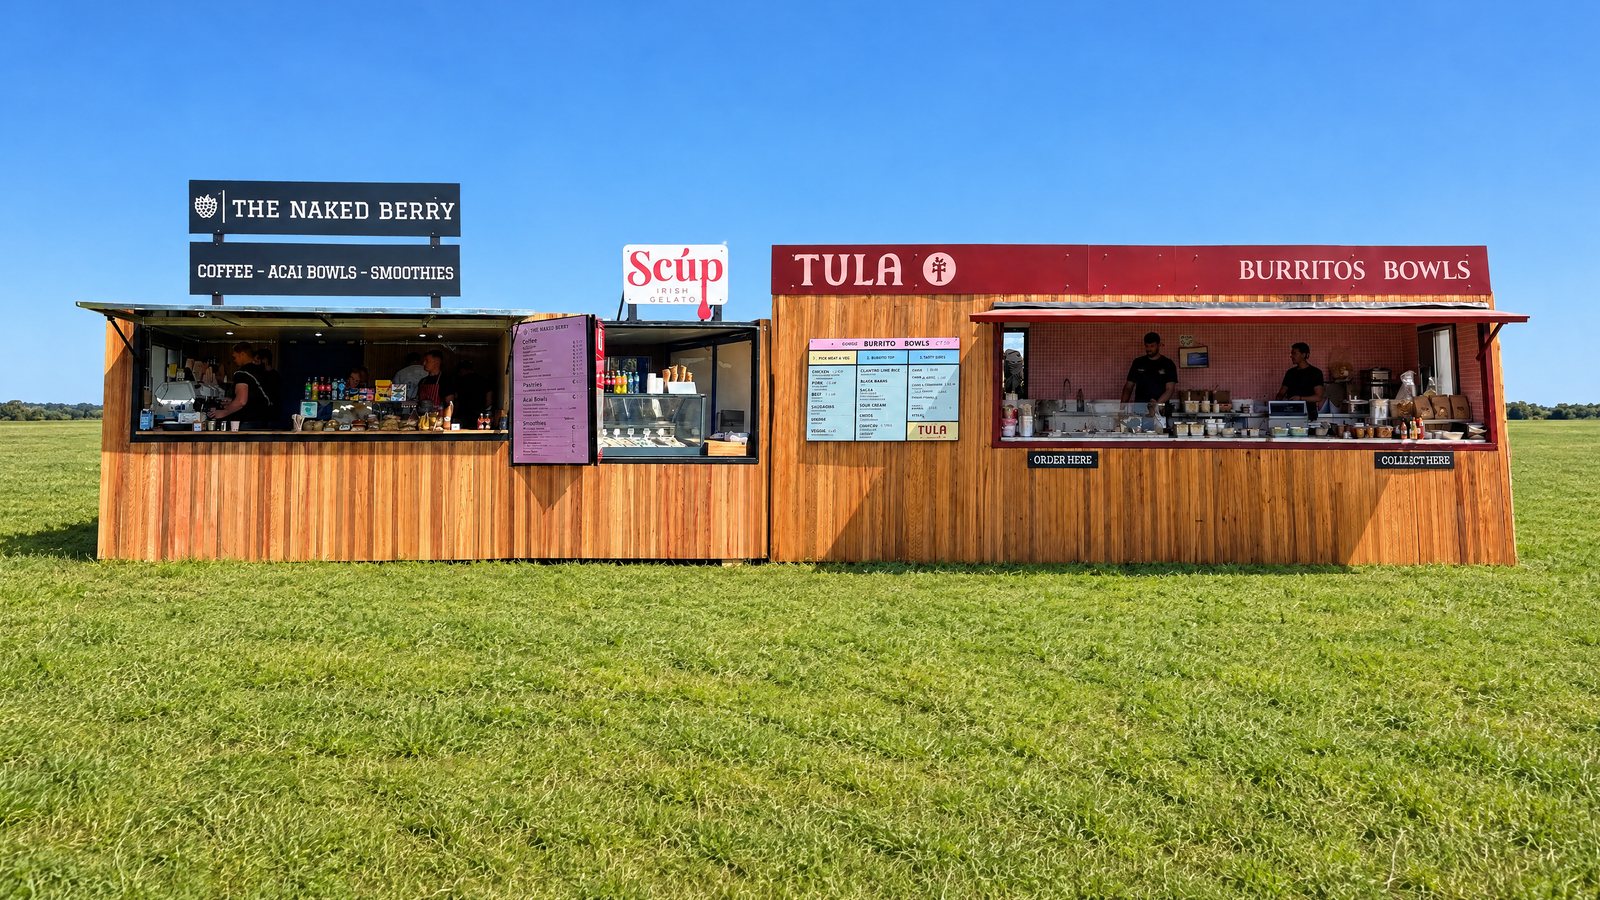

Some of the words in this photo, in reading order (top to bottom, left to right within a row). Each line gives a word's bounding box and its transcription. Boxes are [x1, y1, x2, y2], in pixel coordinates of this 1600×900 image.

[232, 199, 279, 219] THE
[290, 200, 369, 220] NAKED
[379, 201, 455, 221] BERRY
[197, 264, 253, 279] COFFEE
[267, 264, 303, 279] ACAI
[307, 265, 357, 280] BOWLS
[370, 265, 454, 281] SMOOTHIES
[627, 247, 723, 308] Scúp
[794, 252, 904, 286] TULA
[1239, 260, 1366, 280] BURRITOS
[1384, 260, 1471, 280] BOWLS
[917, 425, 947, 435] TULA
[1033, 455, 1065, 465] ORDER
[1067, 455, 1092, 465] HERE
[1425, 455, 1451, 465] HERE
